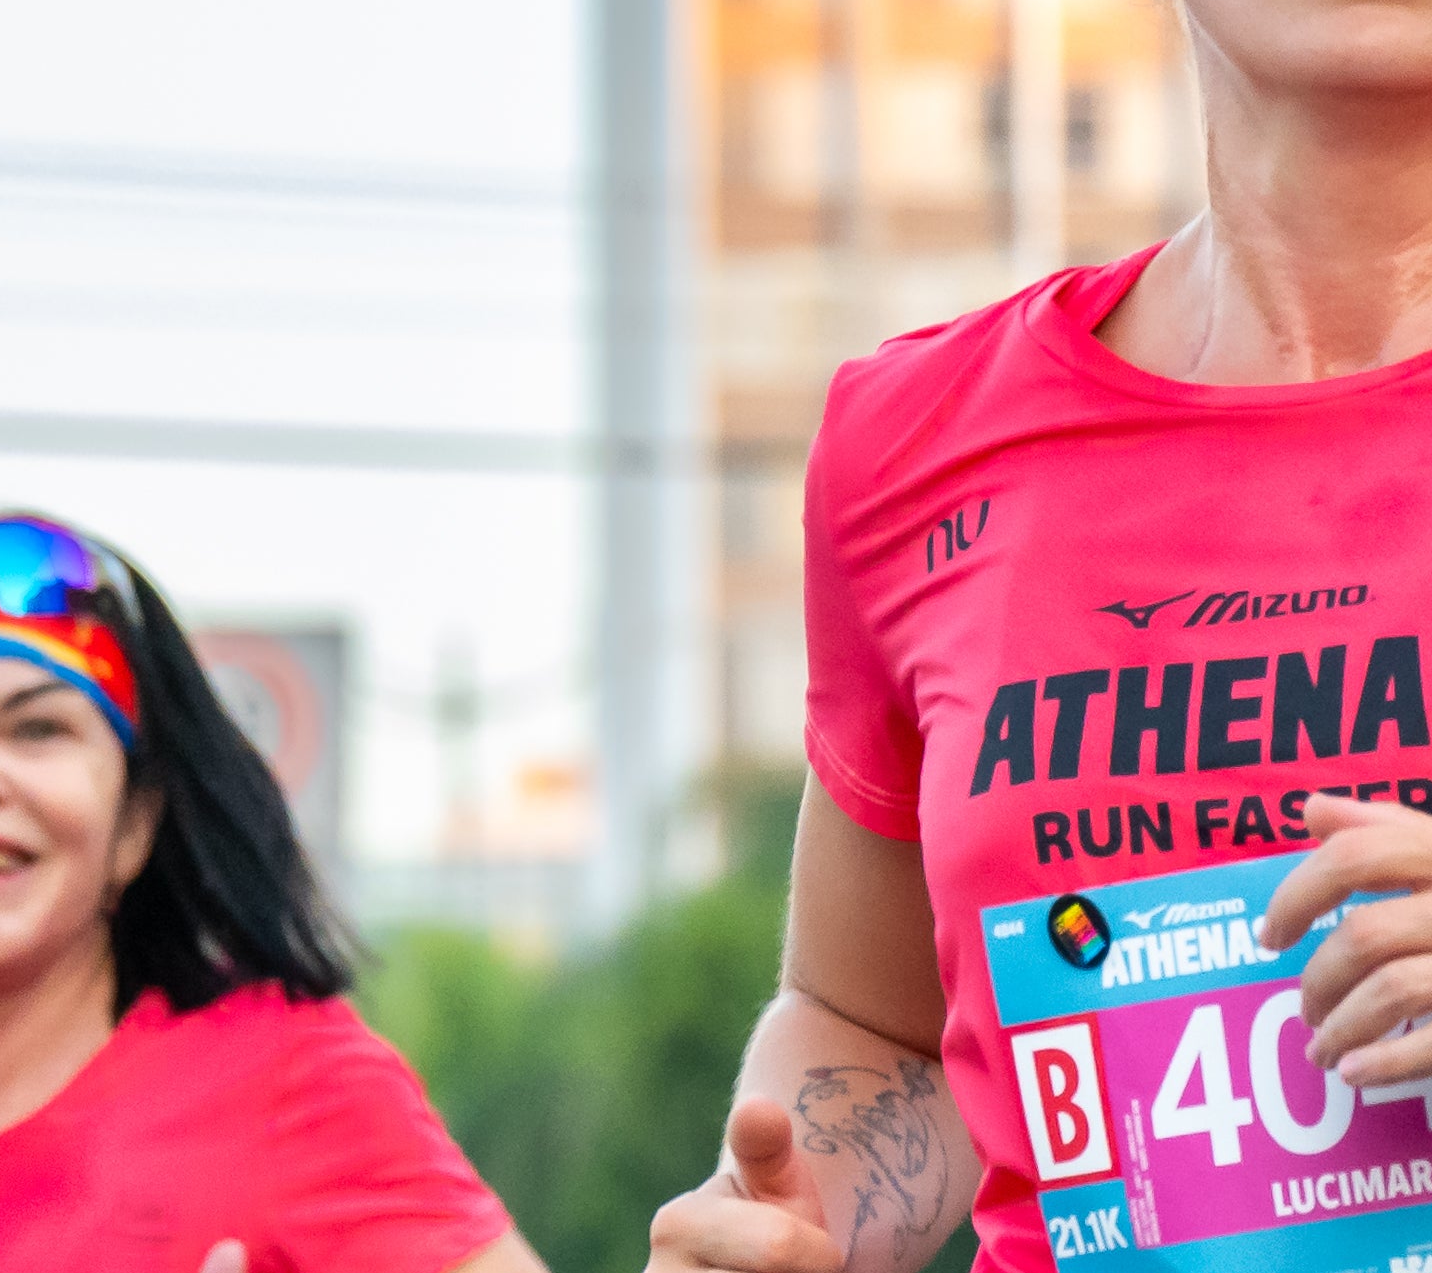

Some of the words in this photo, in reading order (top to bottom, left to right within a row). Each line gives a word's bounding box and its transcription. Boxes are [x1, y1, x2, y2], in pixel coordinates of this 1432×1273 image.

[1032, 801, 1174, 865] RUN
[1033, 1046, 1091, 1165] B
[1048, 1206, 1129, 1259] 21.1K
